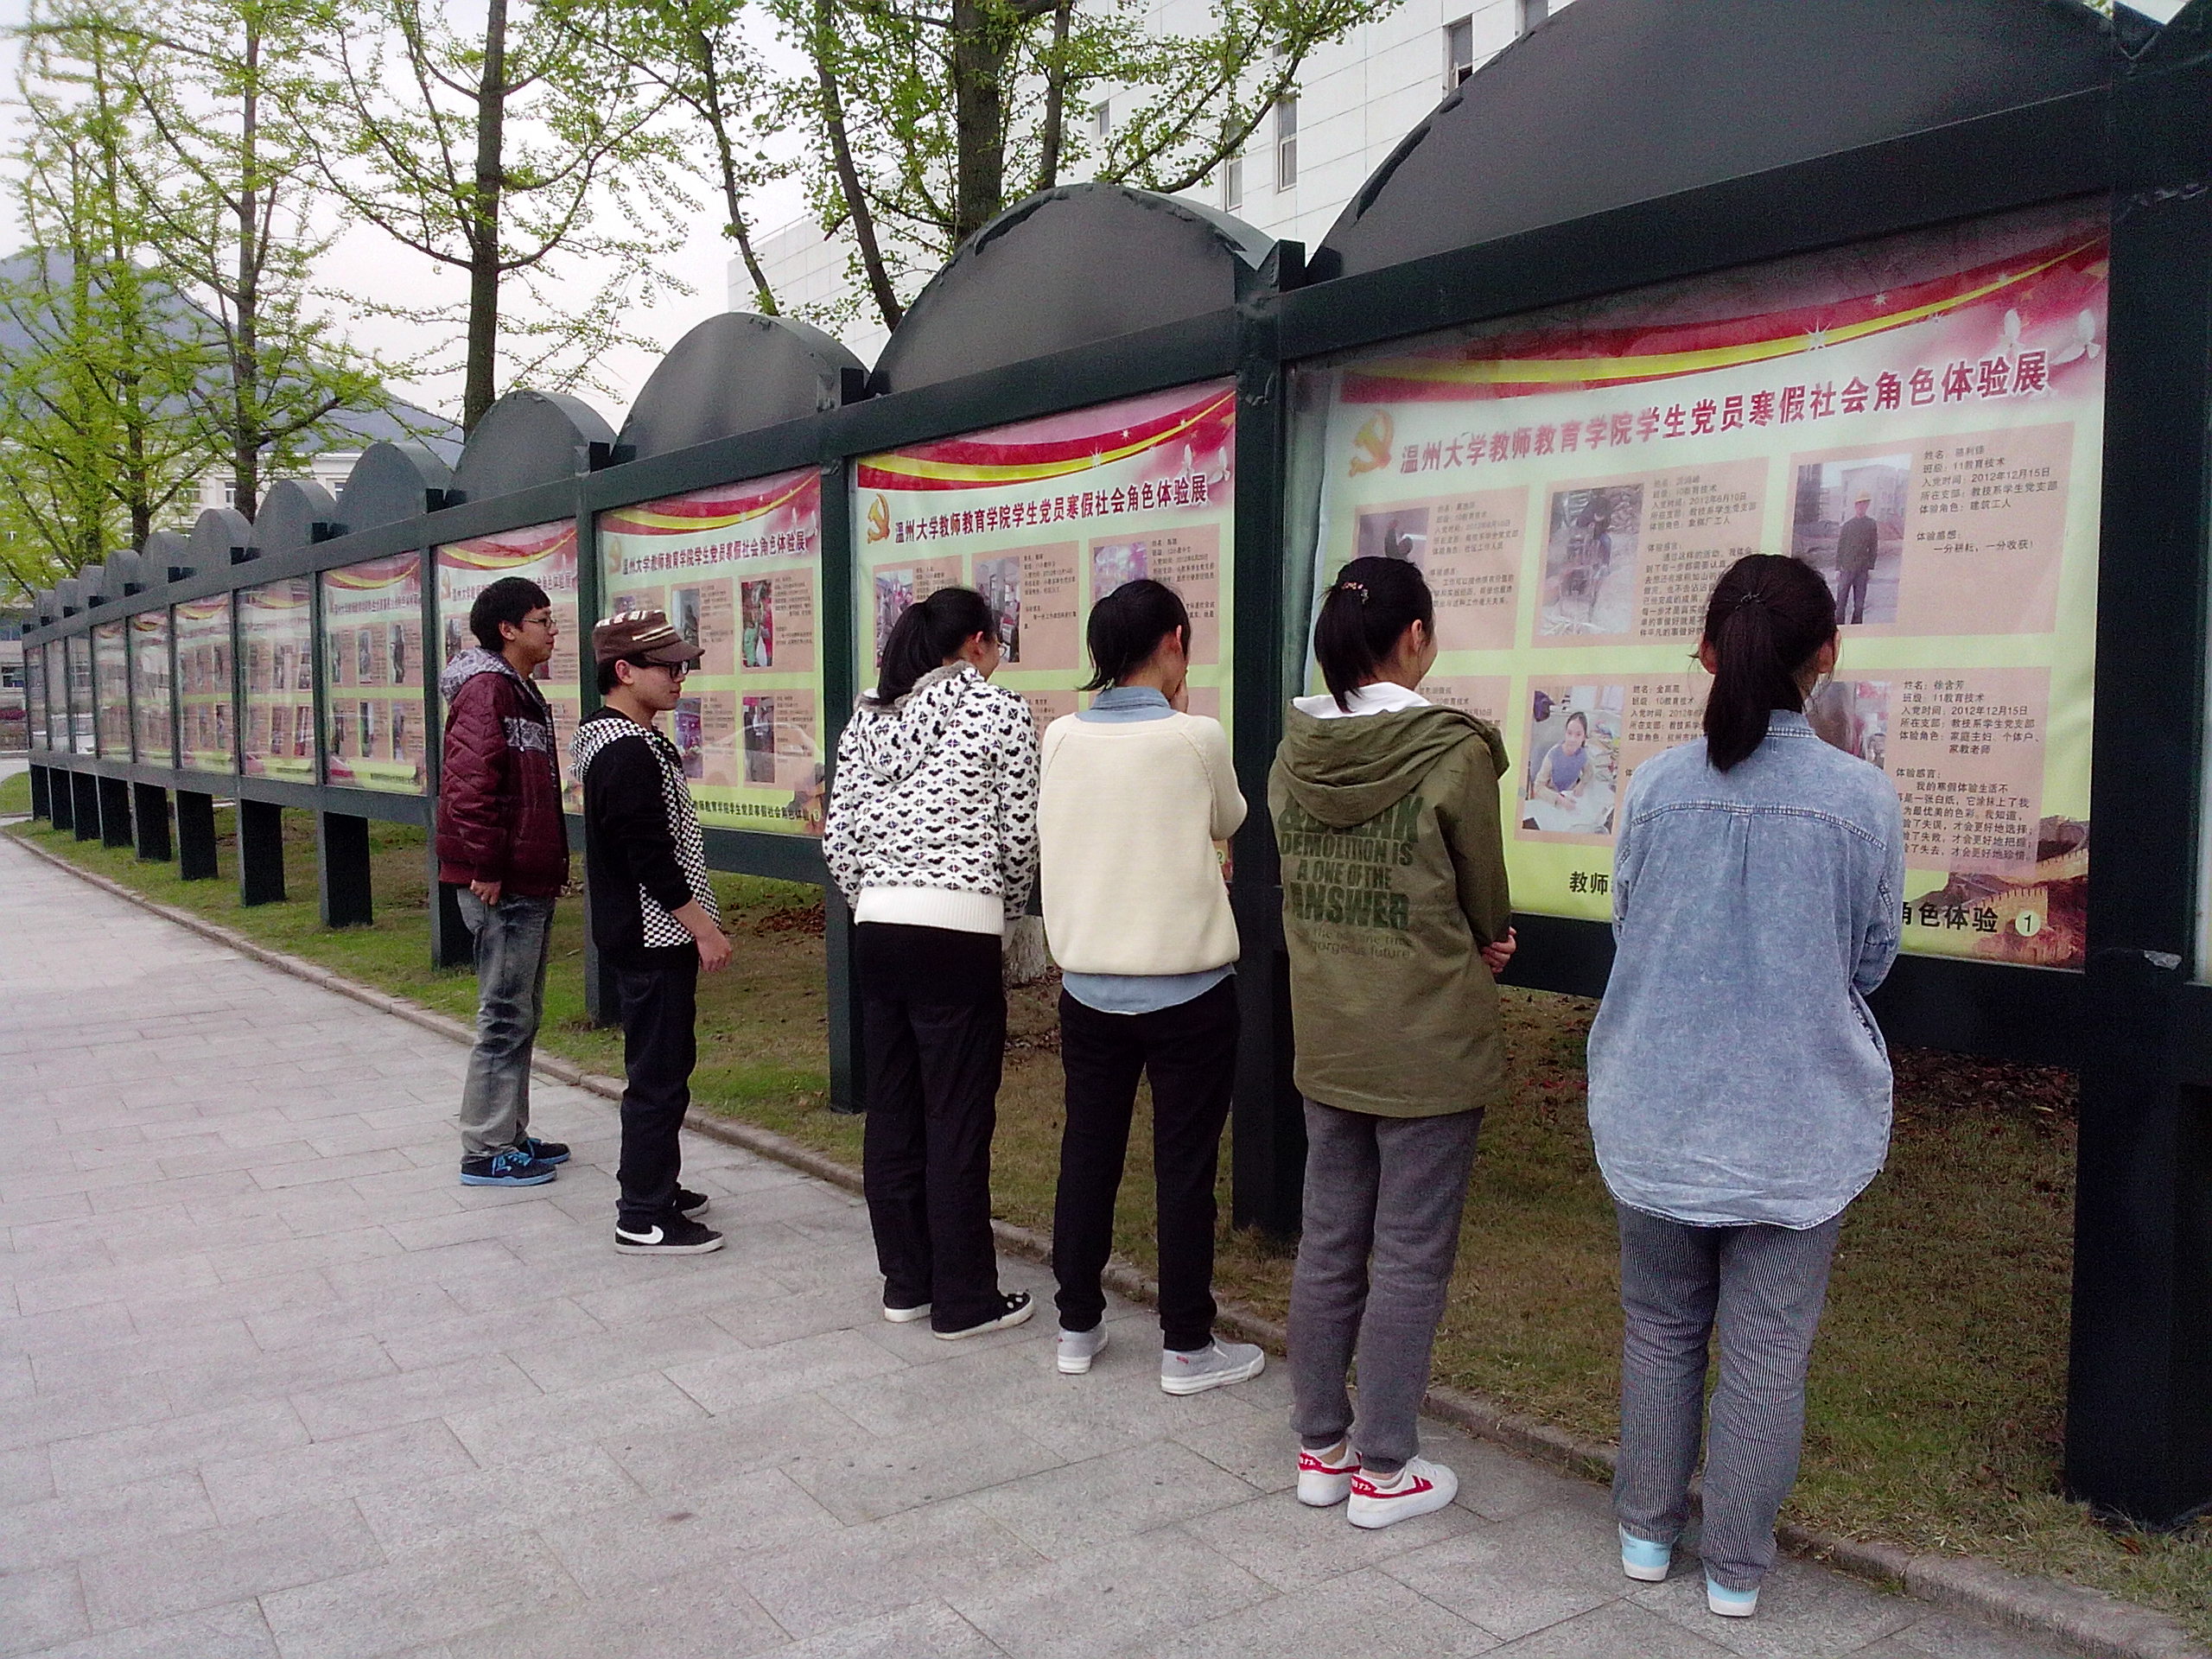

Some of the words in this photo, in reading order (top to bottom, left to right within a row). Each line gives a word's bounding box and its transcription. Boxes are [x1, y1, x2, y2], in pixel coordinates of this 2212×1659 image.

[1399, 350, 2049, 474] 温州大学教师教育学院学生党员寒假社会角色体验展
[894, 474, 1208, 545] 温州大学教师教育学院学生党员寒假社会角色体验展
[1901, 705, 2028, 716] 入党时间：2012年12月15日
[1900, 718, 2035, 730] 所在支部：教技系学生党支部
[1948, 743, 1991, 755] 家教老师
[1916, 781, 2009, 794] 我的寒假体验生活不
[1569, 871, 1609, 895] 教师
[1290, 881, 1410, 931] ANSWER
[2024, 914, 2031, 932] 1
